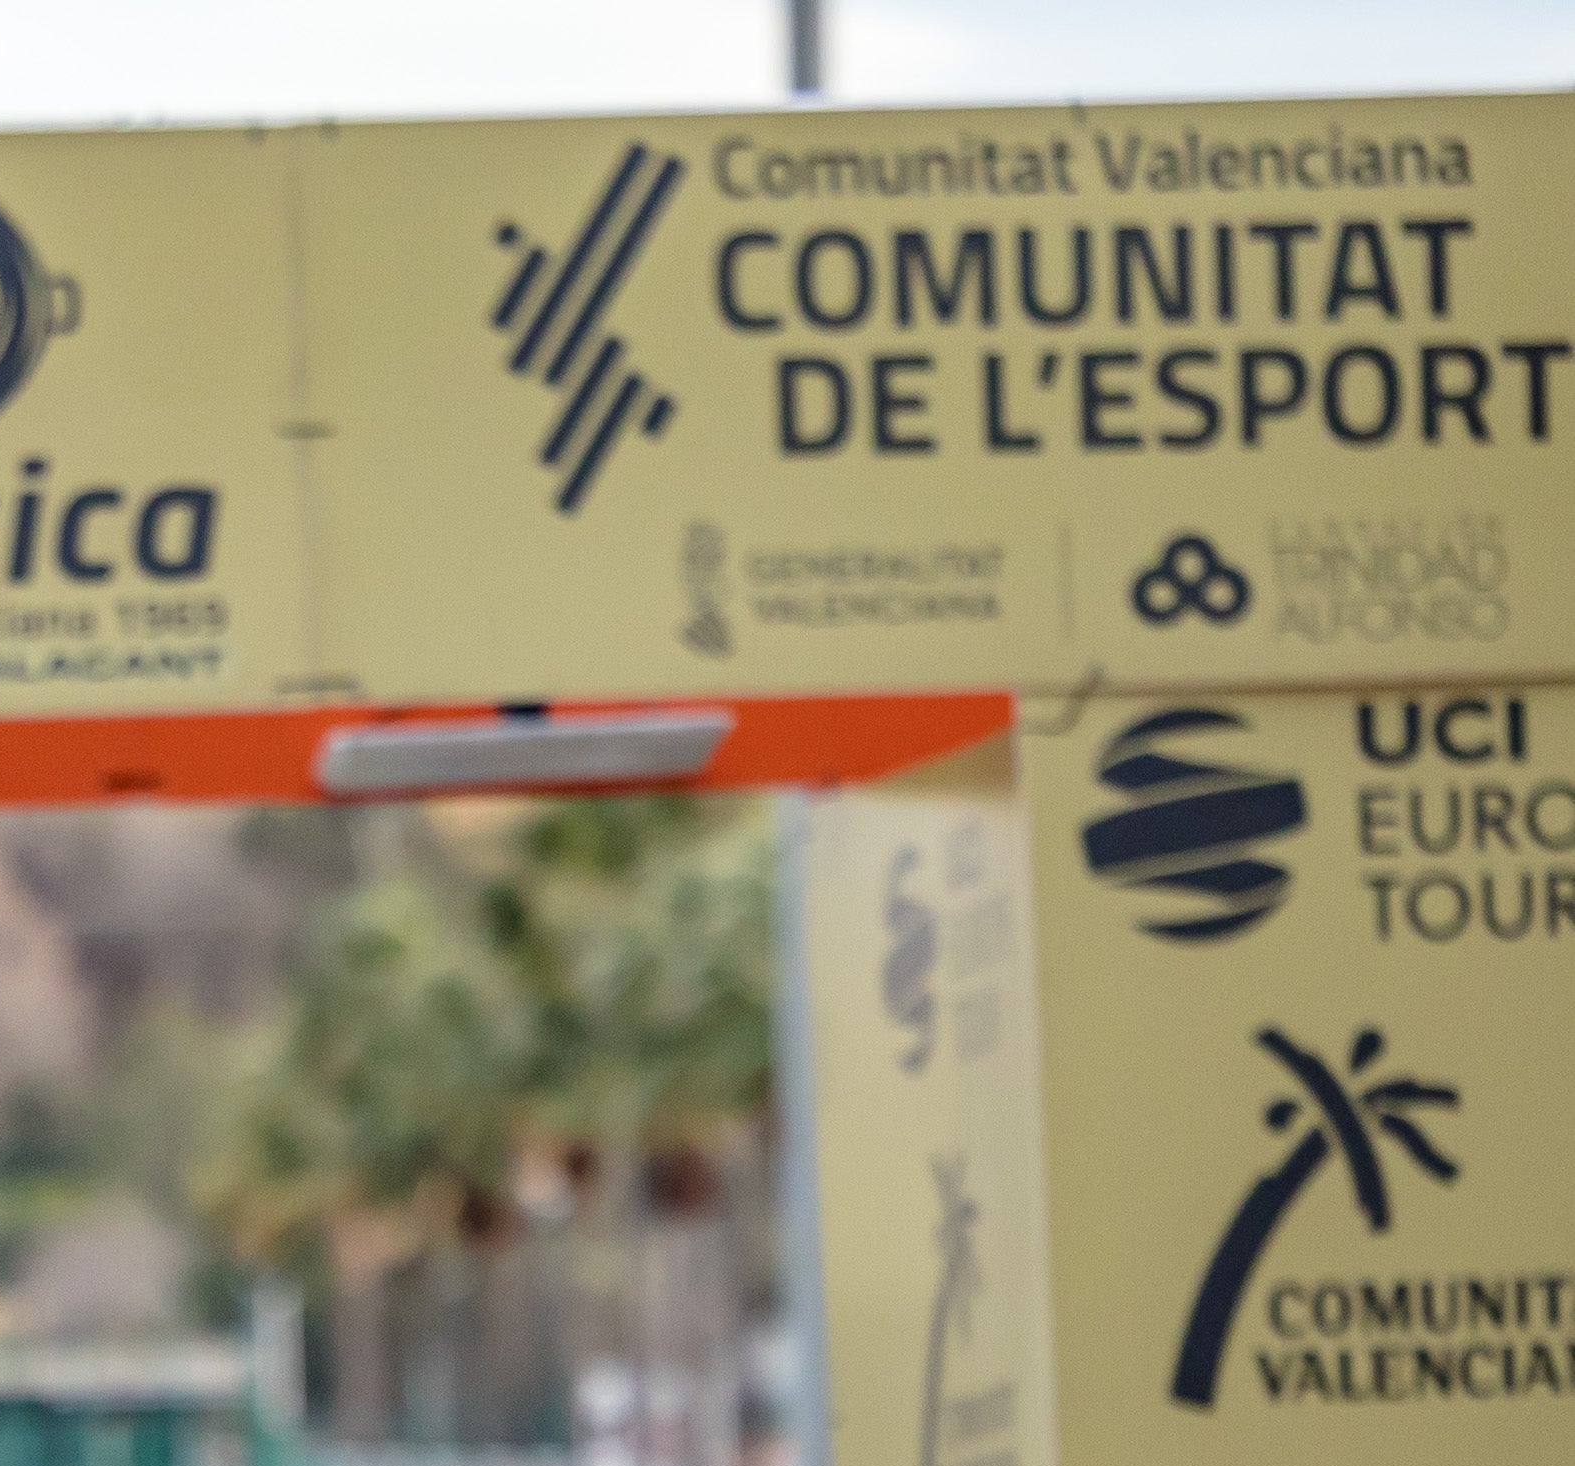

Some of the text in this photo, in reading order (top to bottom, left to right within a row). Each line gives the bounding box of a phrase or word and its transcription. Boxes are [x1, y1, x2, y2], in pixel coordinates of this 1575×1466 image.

[711, 122, 1473, 202] Comunitat Valenciana
[713, 216, 1476, 334] COMUNITAT
[775, 338, 1574, 456] DE L'ESPORT
[1357, 695, 1526, 768] UCI
[1358, 778, 1575, 857] EURO
[1256, 1344, 1575, 1405] VALENCIA
